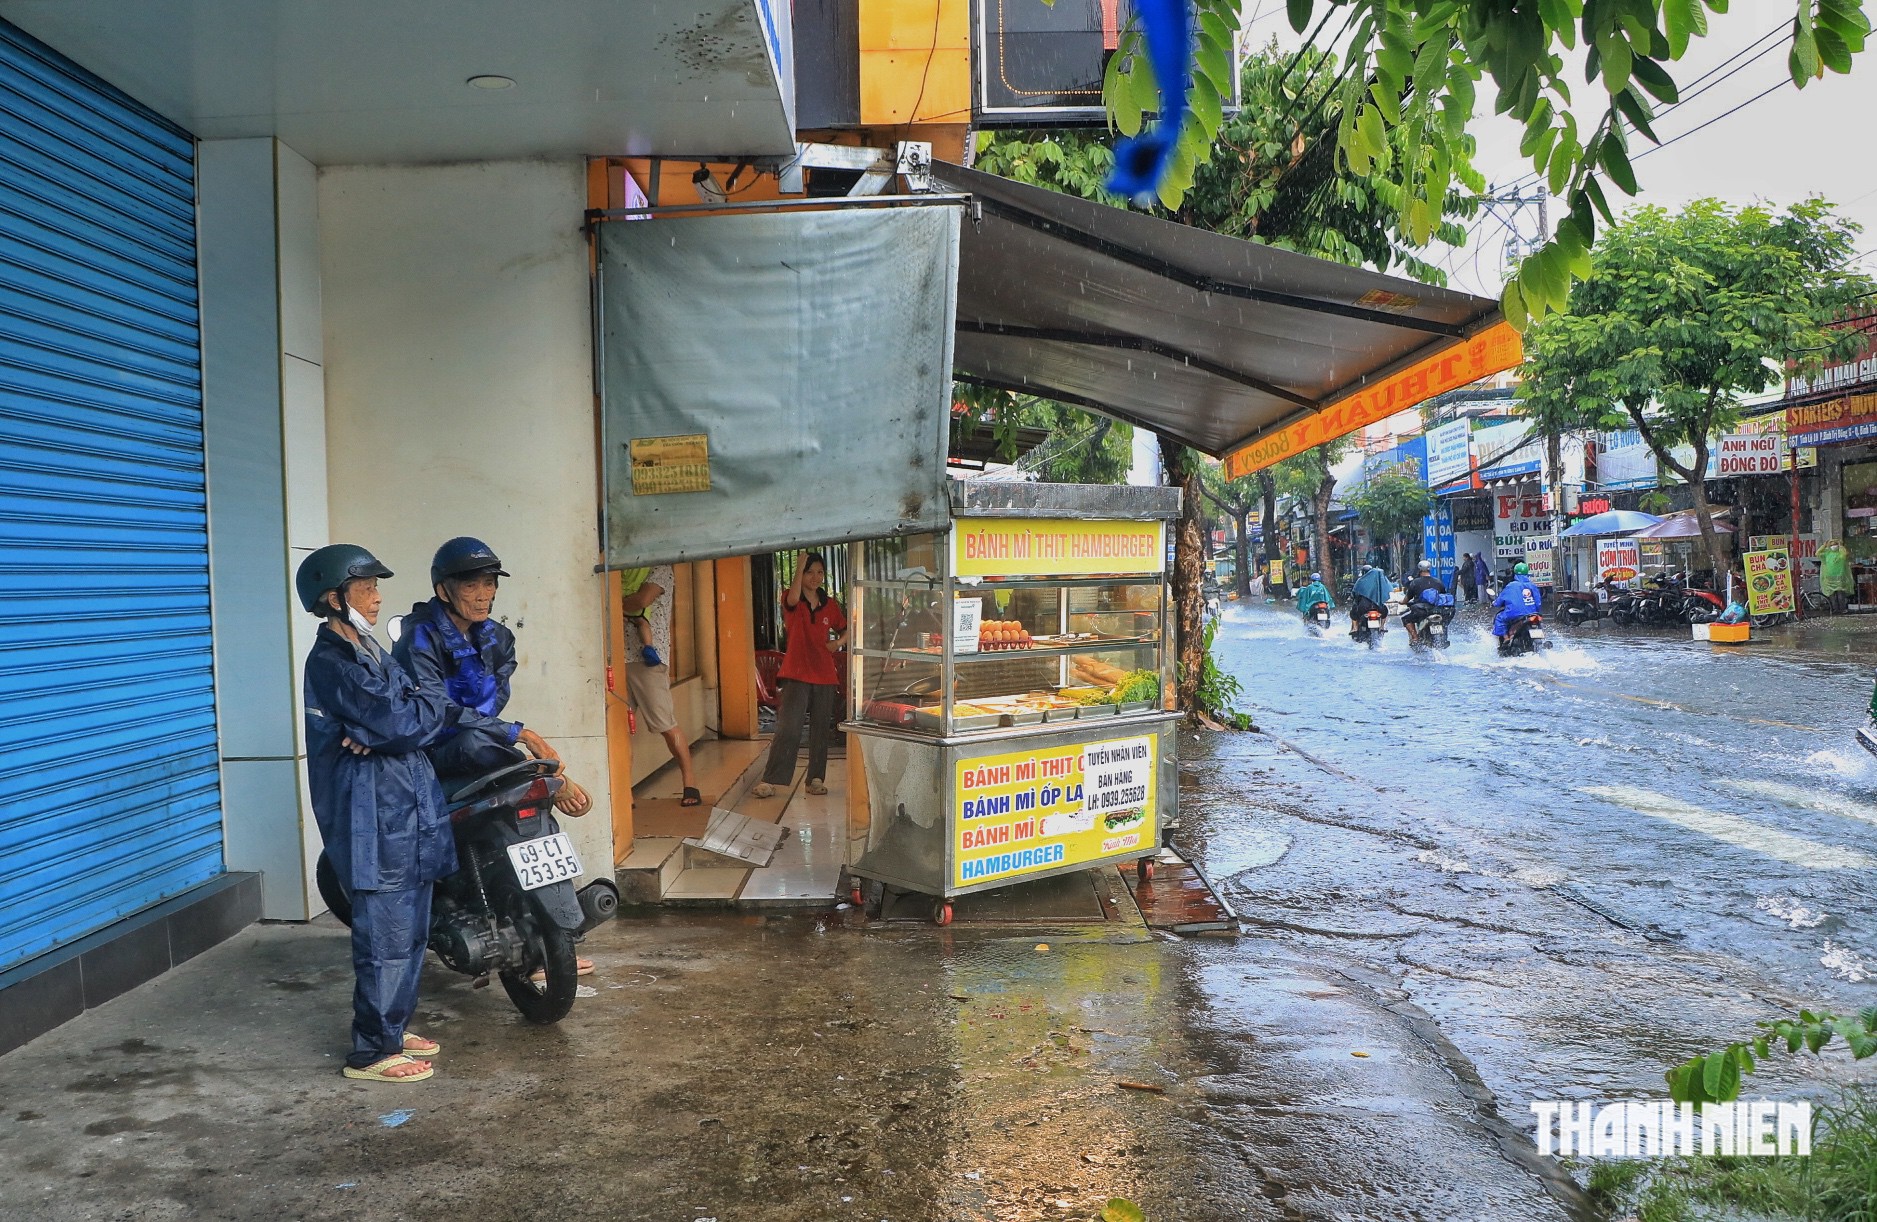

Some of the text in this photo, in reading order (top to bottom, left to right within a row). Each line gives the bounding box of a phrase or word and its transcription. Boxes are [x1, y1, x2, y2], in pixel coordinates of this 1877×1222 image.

[1791, 399, 1843, 427] STARTERS
[1722, 437, 1777, 452] ANH NGỮ
[1720, 454, 1757, 473] ĐÔNG
[1759, 452, 1778, 471] ĐÔ
[966, 528, 1154, 562] BÁNH MÌ THỊT HAMBURGER
[1526, 539, 1537, 552] LÒ
[1087, 745, 1110, 766] TUYỂN
[1111, 745, 1130, 763] NHÂN
[1132, 742, 1147, 760] VIÊN
[963, 765, 1010, 789] BÁNH
[1016, 758, 1036, 781] MÌ
[1040, 756, 1074, 779] THỊT
[1098, 769, 1133, 789] BÁN HÀNG
[963, 782, 1084, 819] BÁNH MÌ ỐP LA
[1088, 785, 1146, 811] LH: 0939.255628
[962, 825, 1010, 850] BÁNH
[1014, 817, 1035, 840] MÌ
[519, 838, 563, 864] 69-C1
[962, 844, 1064, 880] HAMBURGER
[520, 856, 578, 887] 253.55
